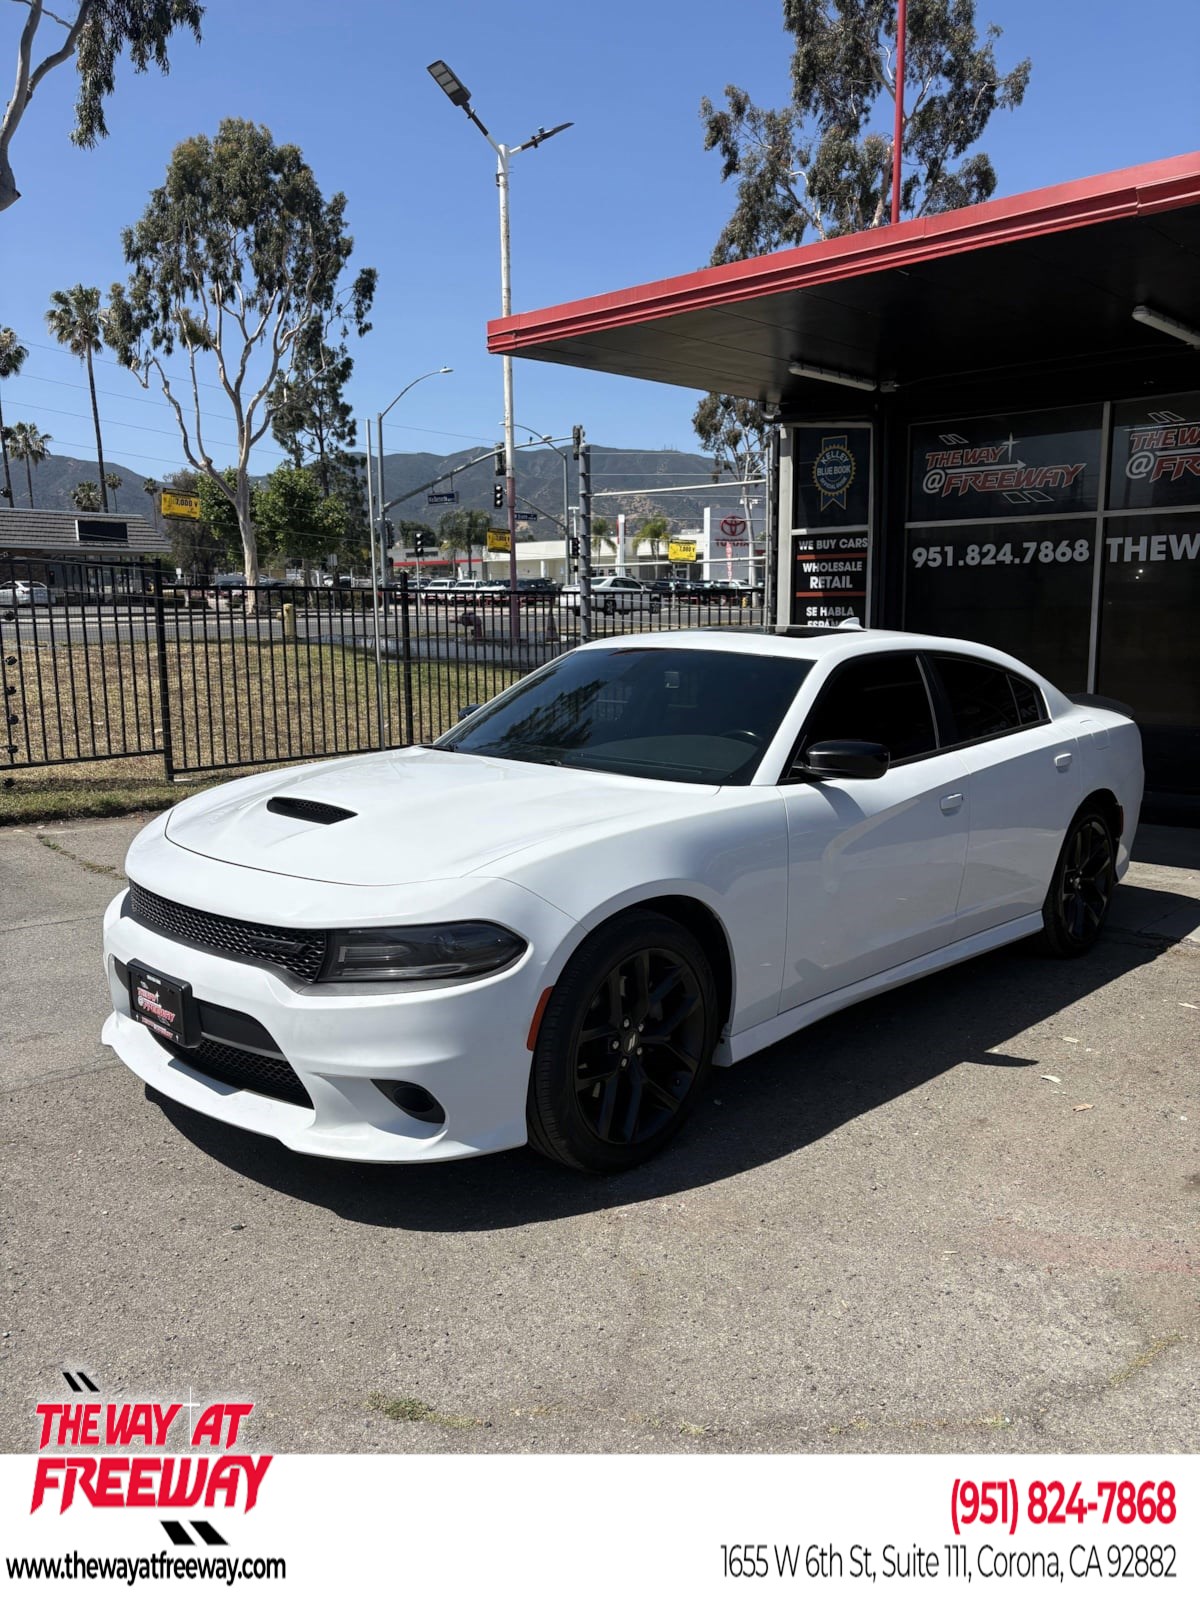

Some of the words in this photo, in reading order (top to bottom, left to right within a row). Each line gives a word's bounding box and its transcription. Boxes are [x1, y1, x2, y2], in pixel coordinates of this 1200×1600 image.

[1130, 428, 1178, 453] THE
[820, 450, 849, 464] KELLEY
[926, 450, 962, 470] THE
[963, 445, 1008, 466] WAY
[817, 466, 833, 476] BLUE
[833, 465, 851, 474] BOOK
[799, 540, 814, 550] WE
[815, 539, 837, 550] BUY
[839, 537, 868, 549] CARS
[912, 539, 1090, 568] 951.824.7868
[802, 561, 862, 573] WHOLESALE
[809, 575, 853, 589] RETAIL
[806, 606, 818, 617] SE
[819, 606, 854, 617] HABLA
